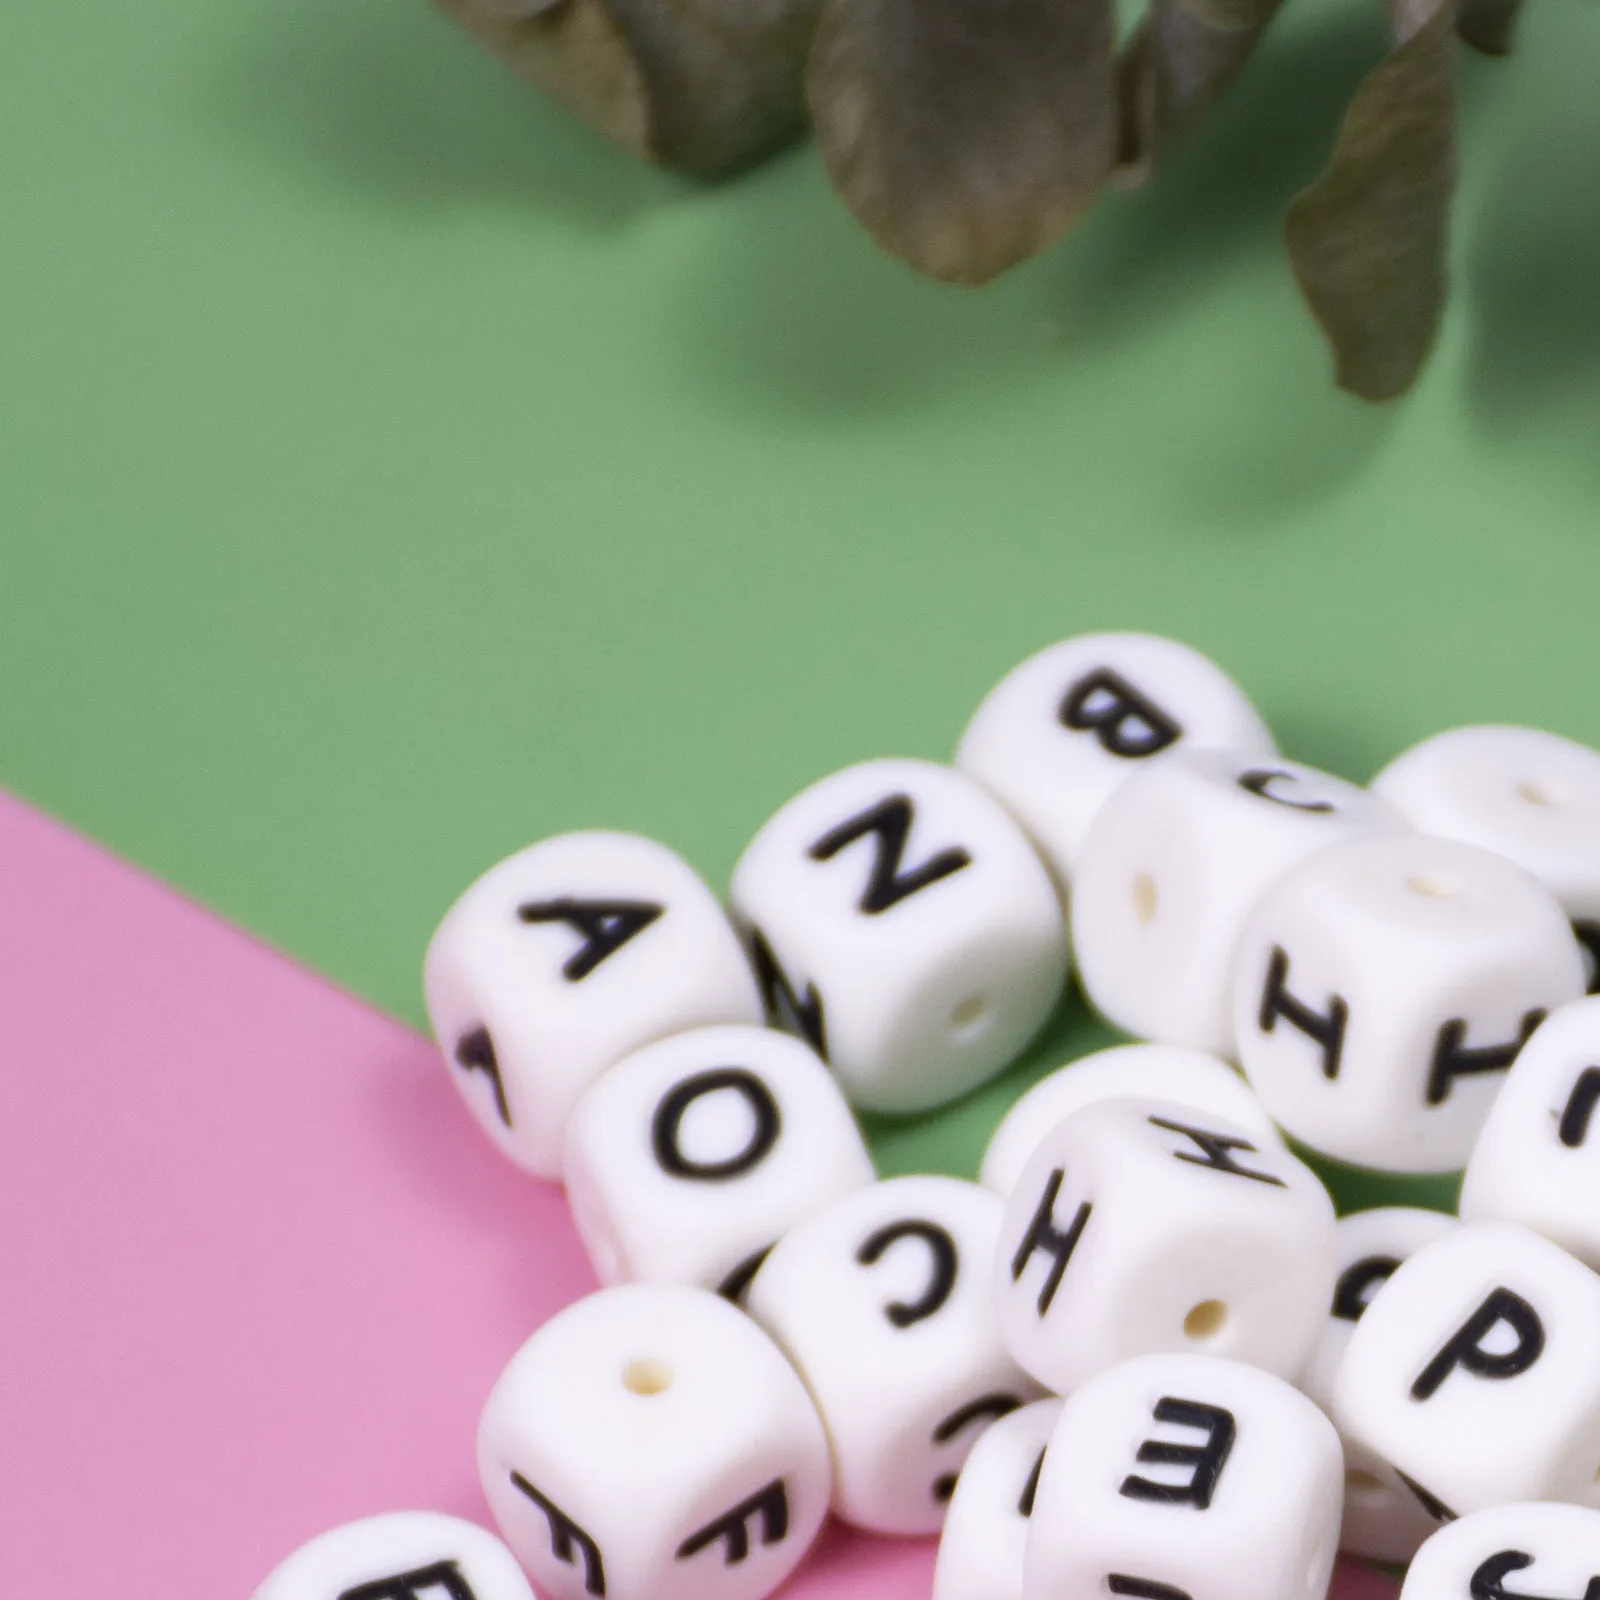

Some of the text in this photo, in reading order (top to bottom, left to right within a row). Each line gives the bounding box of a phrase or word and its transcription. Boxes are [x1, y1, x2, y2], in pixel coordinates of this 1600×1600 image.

[1060, 671, 1181, 759] B
[519, 898, 663, 982] A
[653, 1068, 780, 1182] O
[858, 1220, 959, 1328] C
[1012, 1169, 1092, 1319] H
[1410, 1286, 1545, 1401] P
[1118, 1396, 1236, 1511] E
[676, 1478, 790, 1565] F
